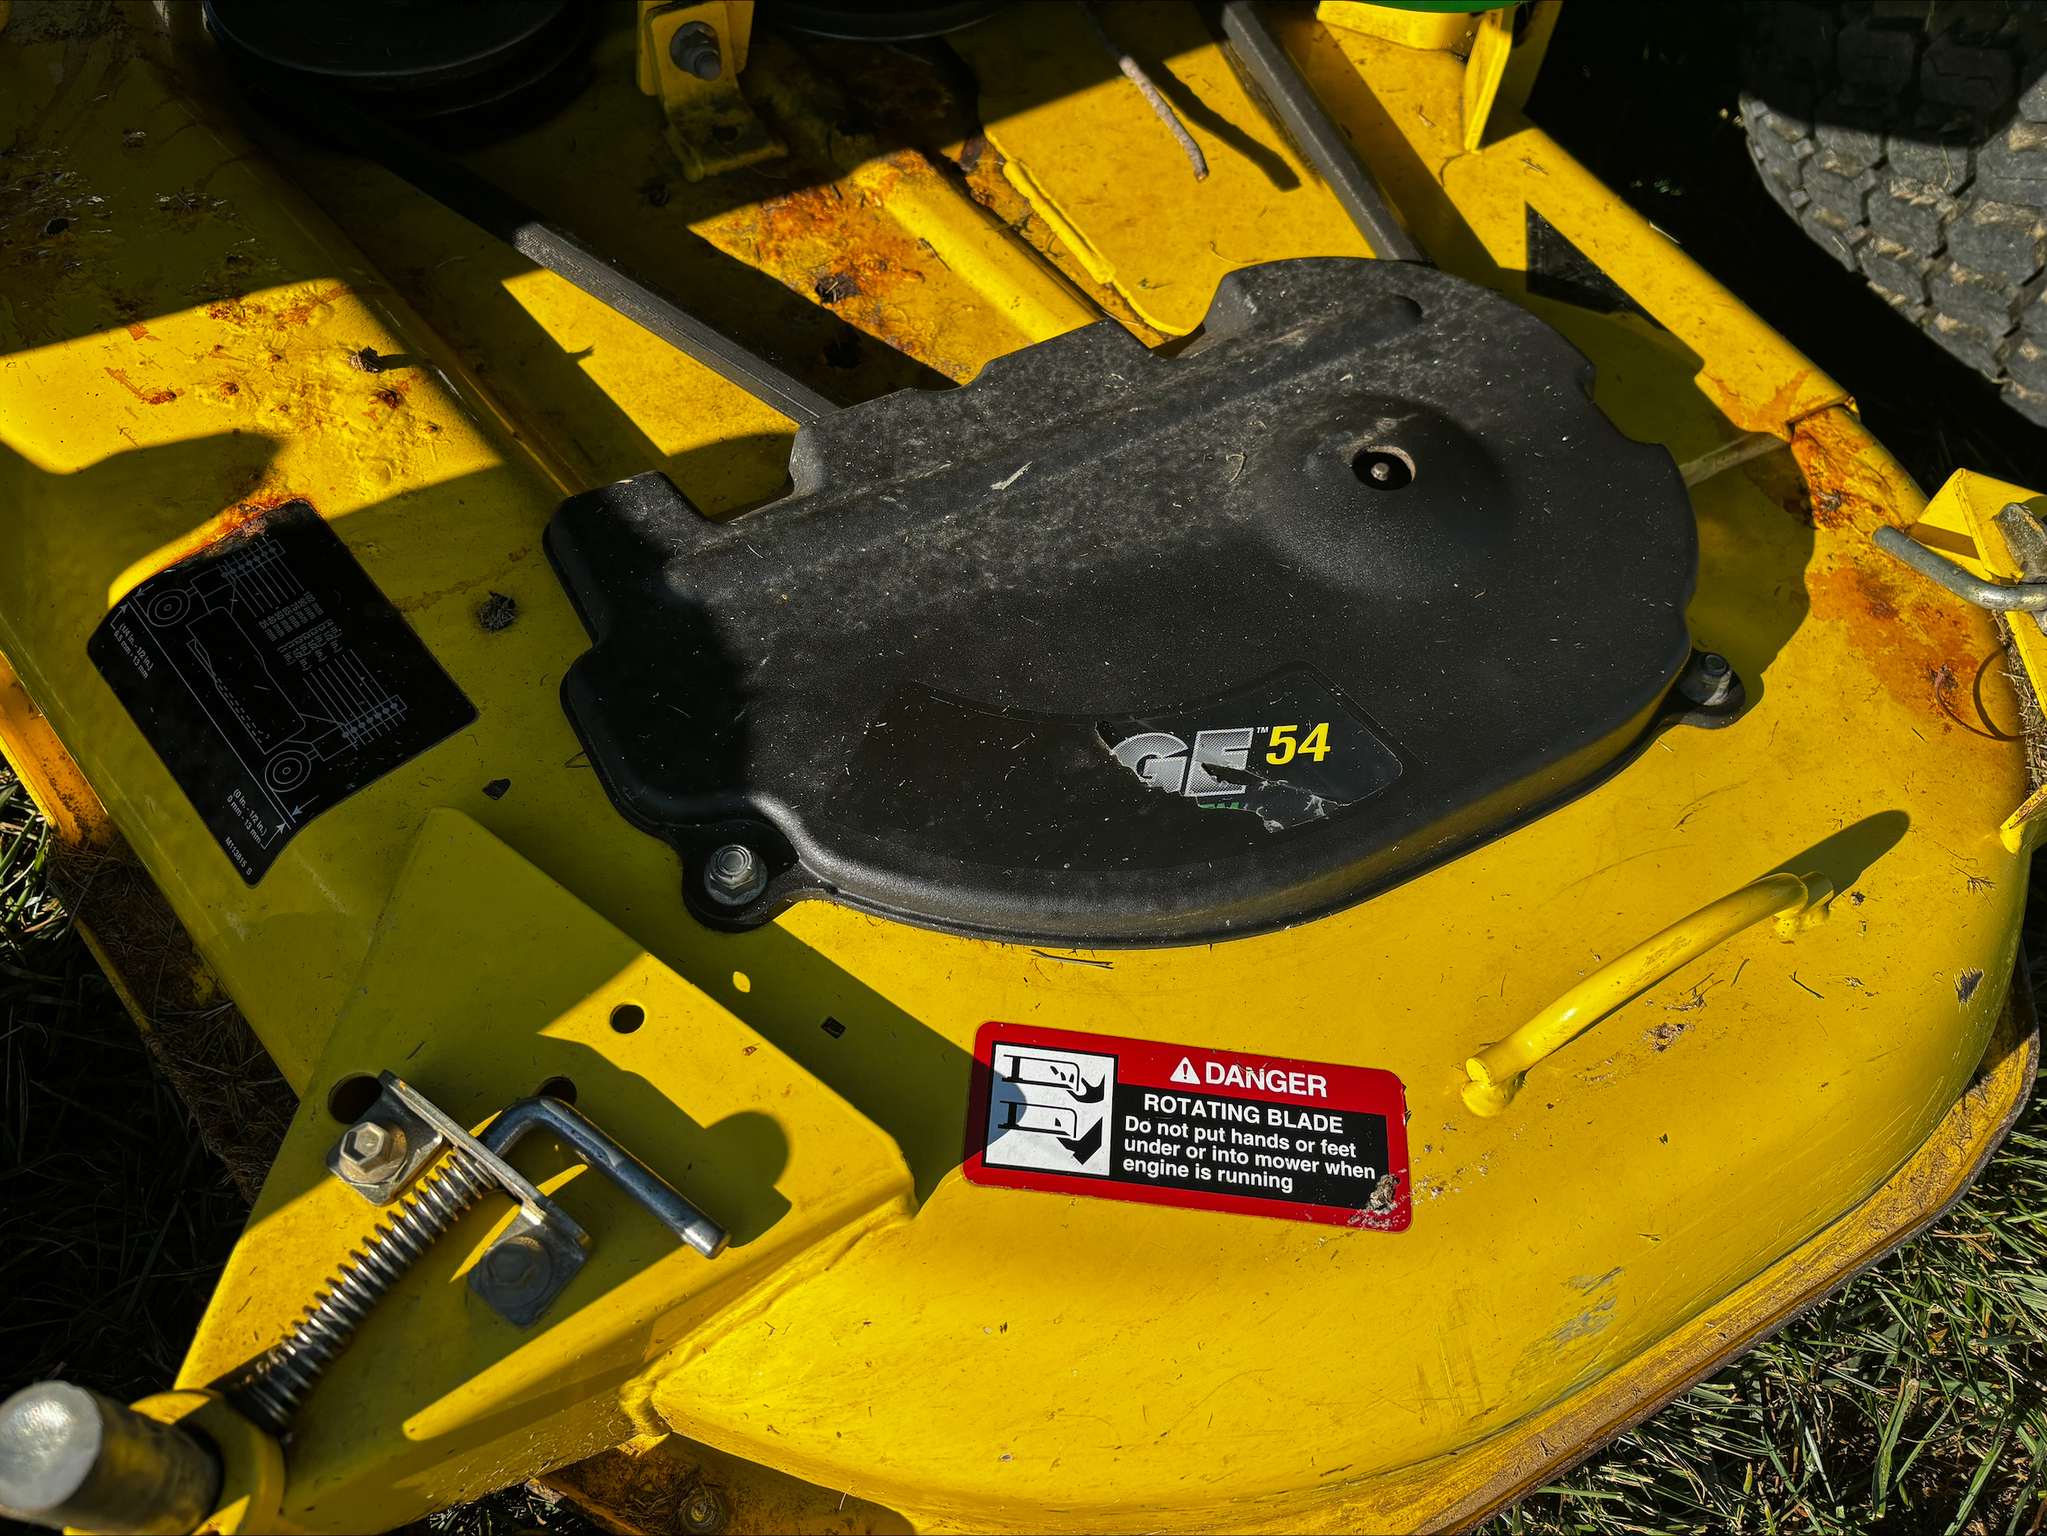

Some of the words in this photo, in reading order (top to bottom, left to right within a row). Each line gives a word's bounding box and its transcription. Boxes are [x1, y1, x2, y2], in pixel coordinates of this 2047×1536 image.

[274, 610, 285, 621] 50
[280, 619, 293, 633] mm
[282, 606, 293, 616] 65
[288, 615, 301, 629] mm
[290, 601, 301, 612] 75
[295, 611, 308, 624] mm
[297, 598, 308, 607] 90
[303, 606, 316, 620] mm
[303, 591, 316, 604] 102
[311, 602, 324, 616] mm
[258, 619, 270, 629] 25
[264, 628, 277, 642] mm
[267, 616, 277, 625] 40
[272, 624, 285, 638] mm
[120, 640, 131, 655] mm
[138, 665, 149, 679] mm
[1266, 722, 1331, 765] 54
[230, 801, 242, 817] mm
[250, 829, 261, 844] mm
[225, 836, 248, 868] M113815
[246, 867, 253, 876] S
[1205, 1061, 1327, 1098] DANGER
[1144, 1093, 1260, 1124] ROTATING
[1267, 1108, 1344, 1134] BLADE
[1125, 1115, 1152, 1134] Do
[1157, 1122, 1189, 1138] not
[1194, 1126, 1226, 1144] put
[1231, 1128, 1290, 1151] hands
[1295, 1139, 1316, 1153] or
[1320, 1138, 1357, 1158] feet
[1123, 1158, 1189, 1178] engine
[1195, 1163, 1212, 1180] is
[1217, 1169, 1293, 1194] running
[1124, 1138, 1180, 1157] under
[1185, 1145, 1207, 1160] or
[1212, 1145, 1249, 1165] into
[1254, 1153, 1320, 1173] mower
[1324, 1160, 1376, 1180] when
